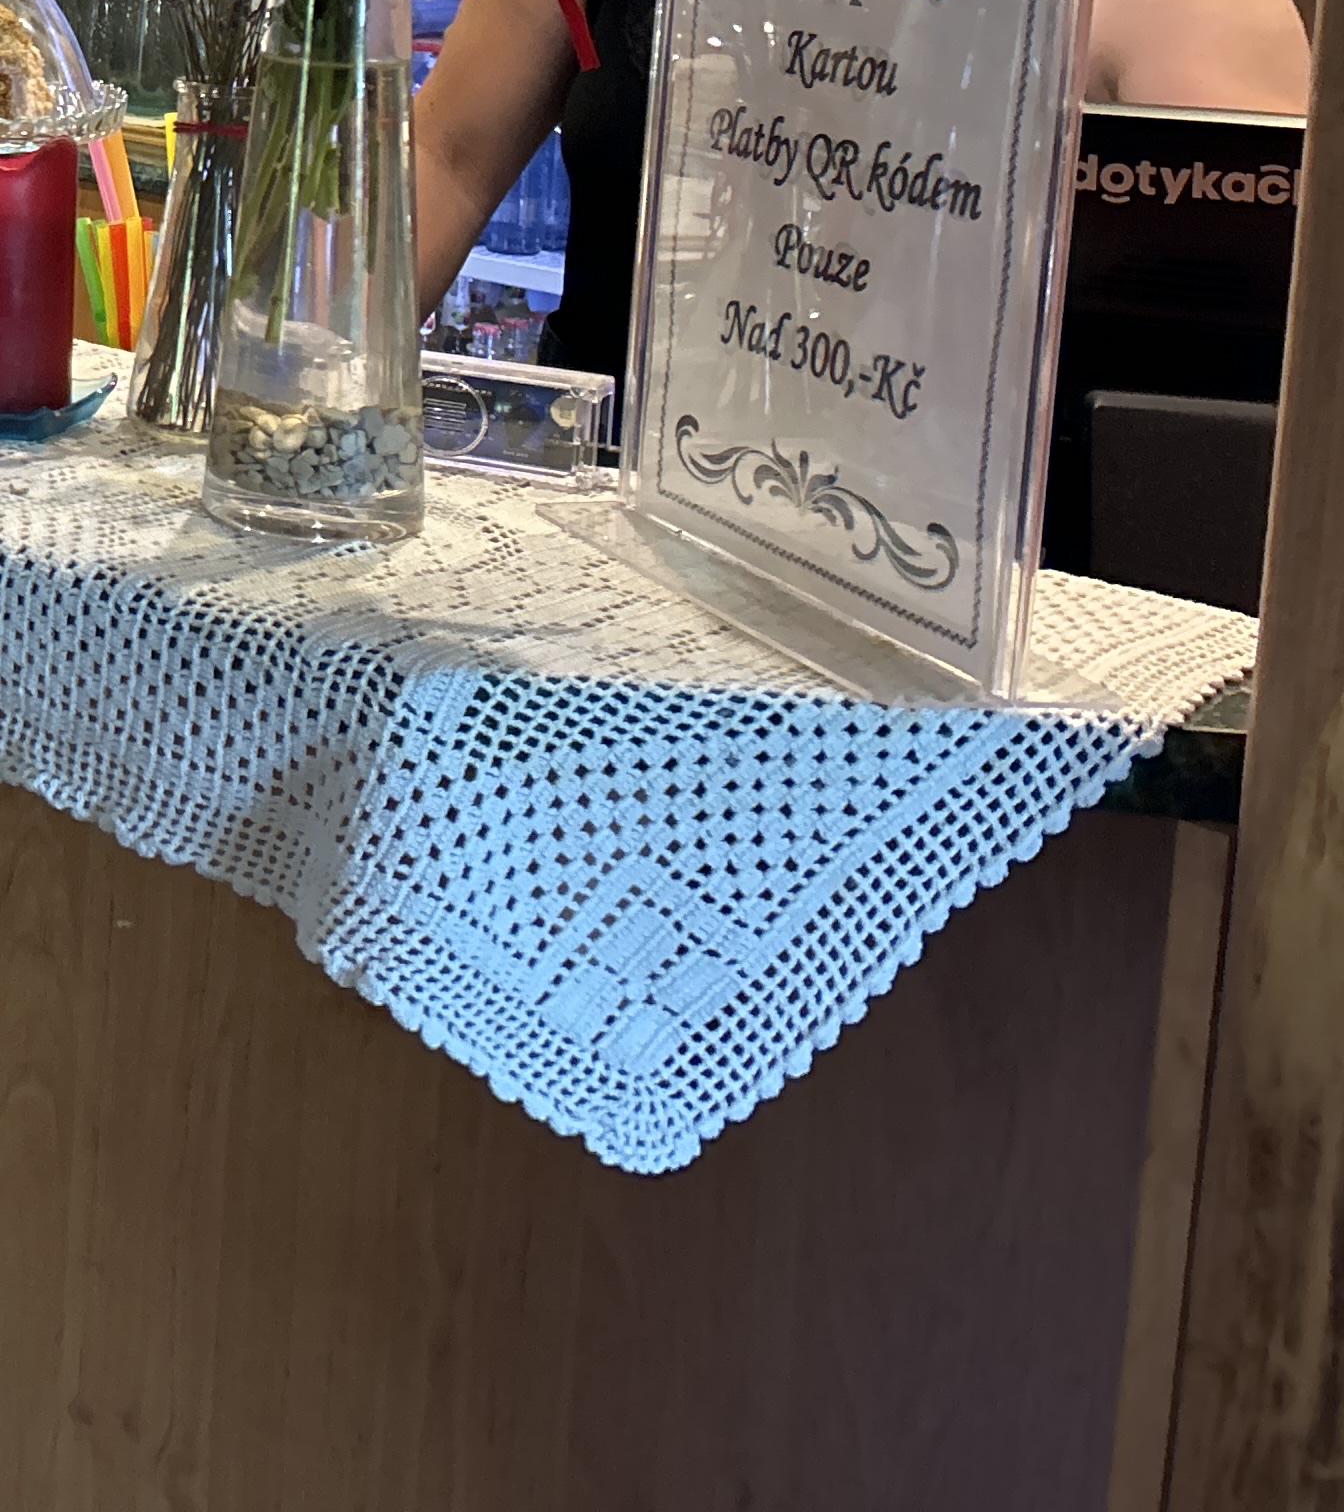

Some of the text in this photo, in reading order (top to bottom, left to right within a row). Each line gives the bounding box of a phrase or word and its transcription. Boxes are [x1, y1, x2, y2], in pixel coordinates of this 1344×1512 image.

[785, 30, 898, 96] Kartou
[710, 106, 982, 220] Platby QR kódem
[774, 223, 871, 292] Pouze
[720, 300, 792, 361] Nad
